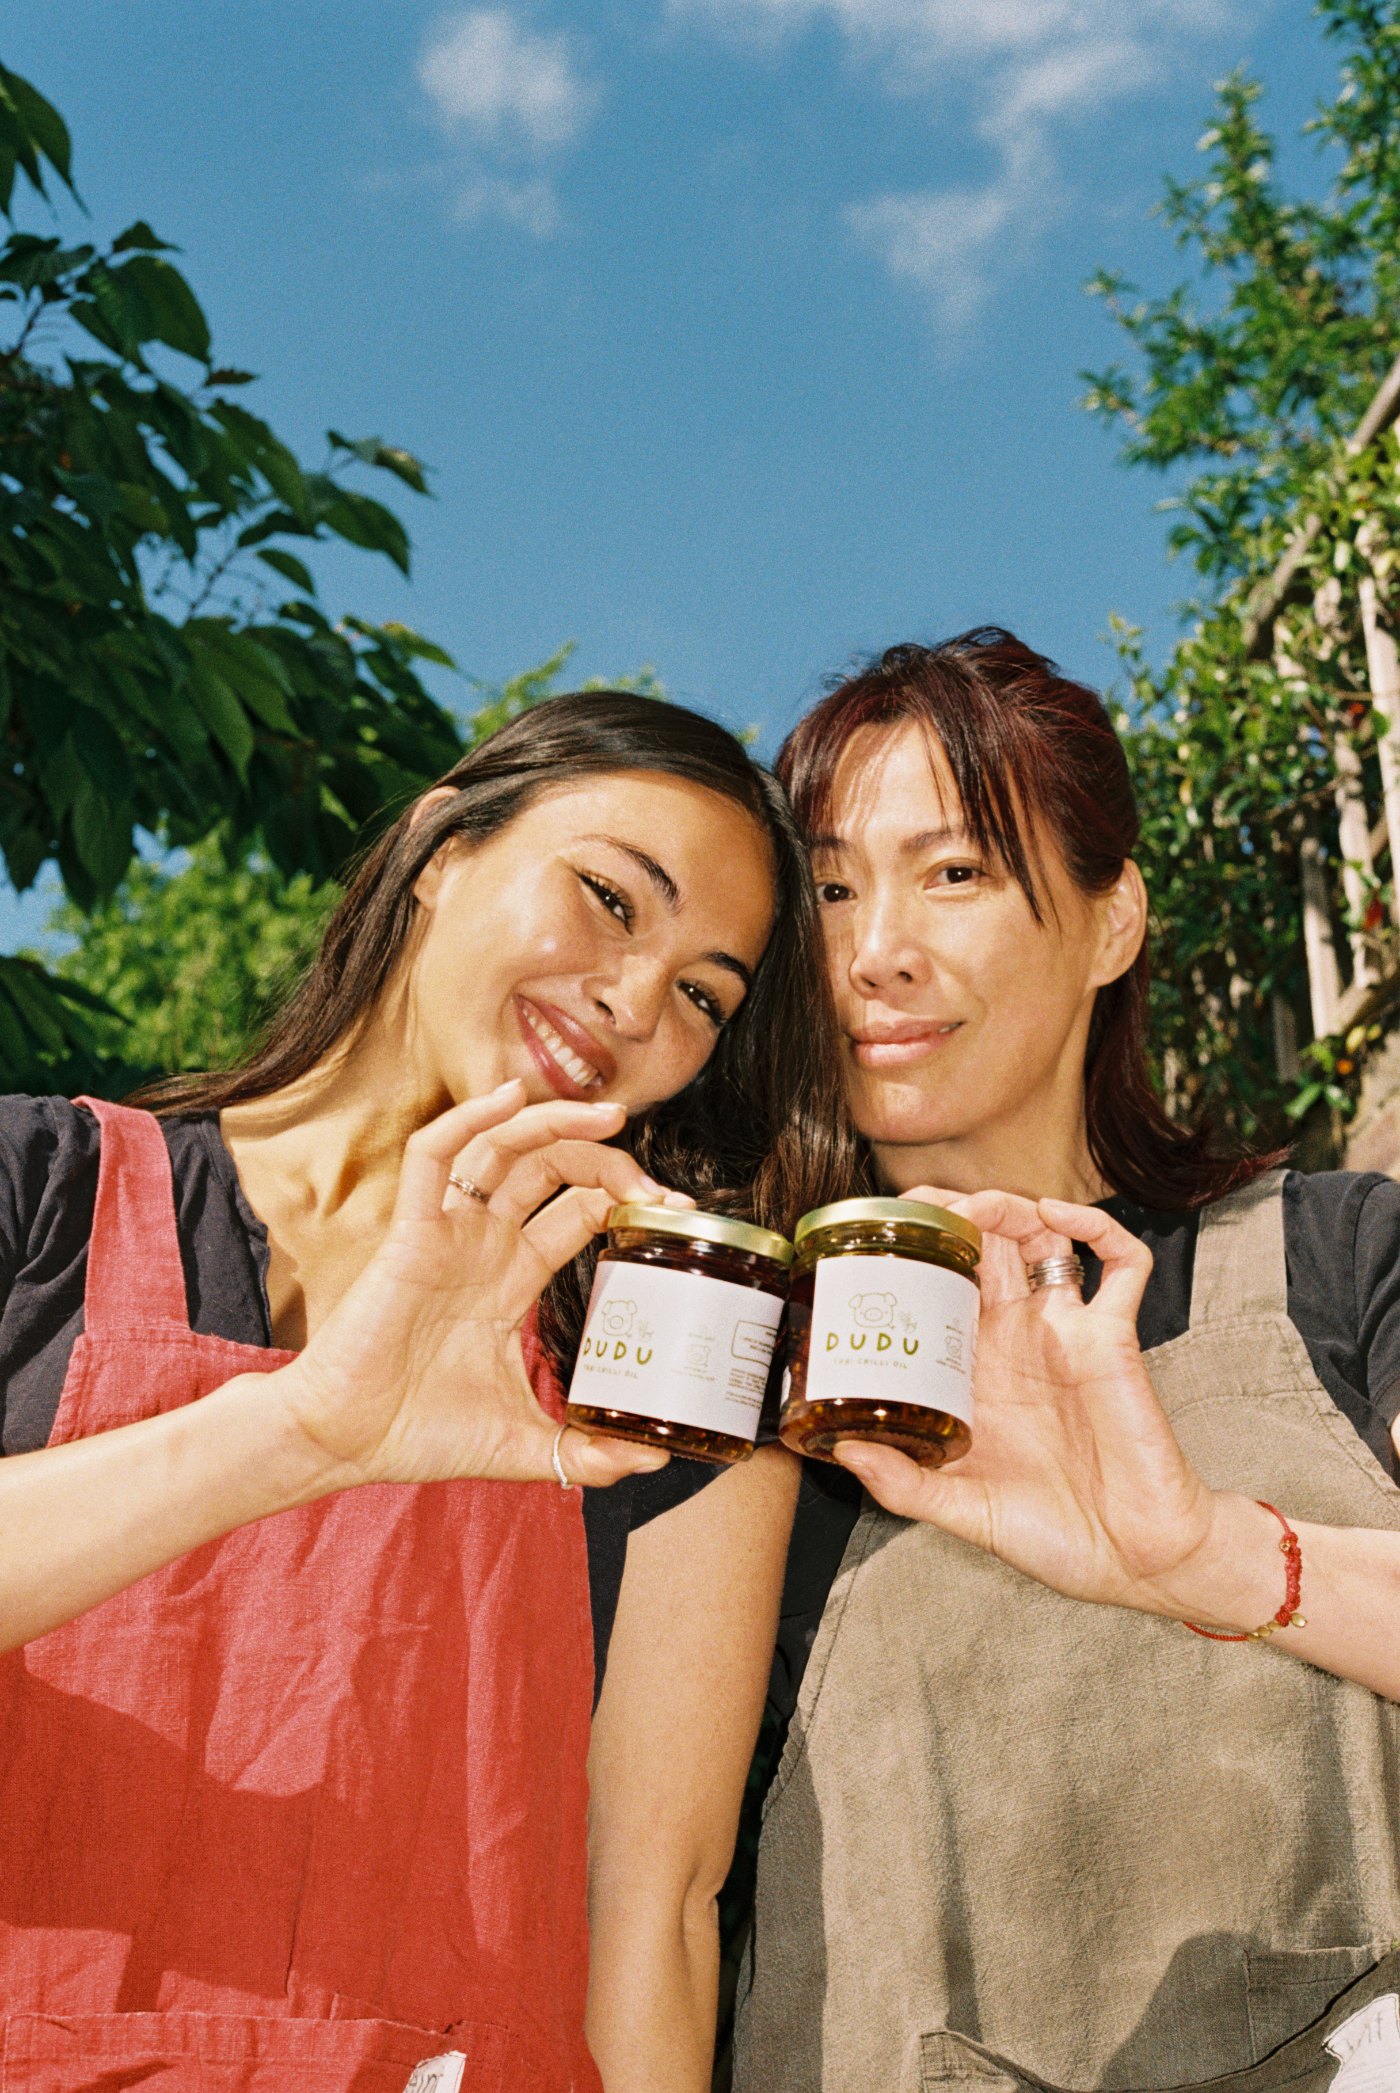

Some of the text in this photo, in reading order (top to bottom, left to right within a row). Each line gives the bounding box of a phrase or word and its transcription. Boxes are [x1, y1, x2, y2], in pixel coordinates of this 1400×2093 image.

[583, 1338, 653, 1364] DUDU
[826, 1332, 919, 1355] DUDU
[893, 1361, 908, 1369] OIL
